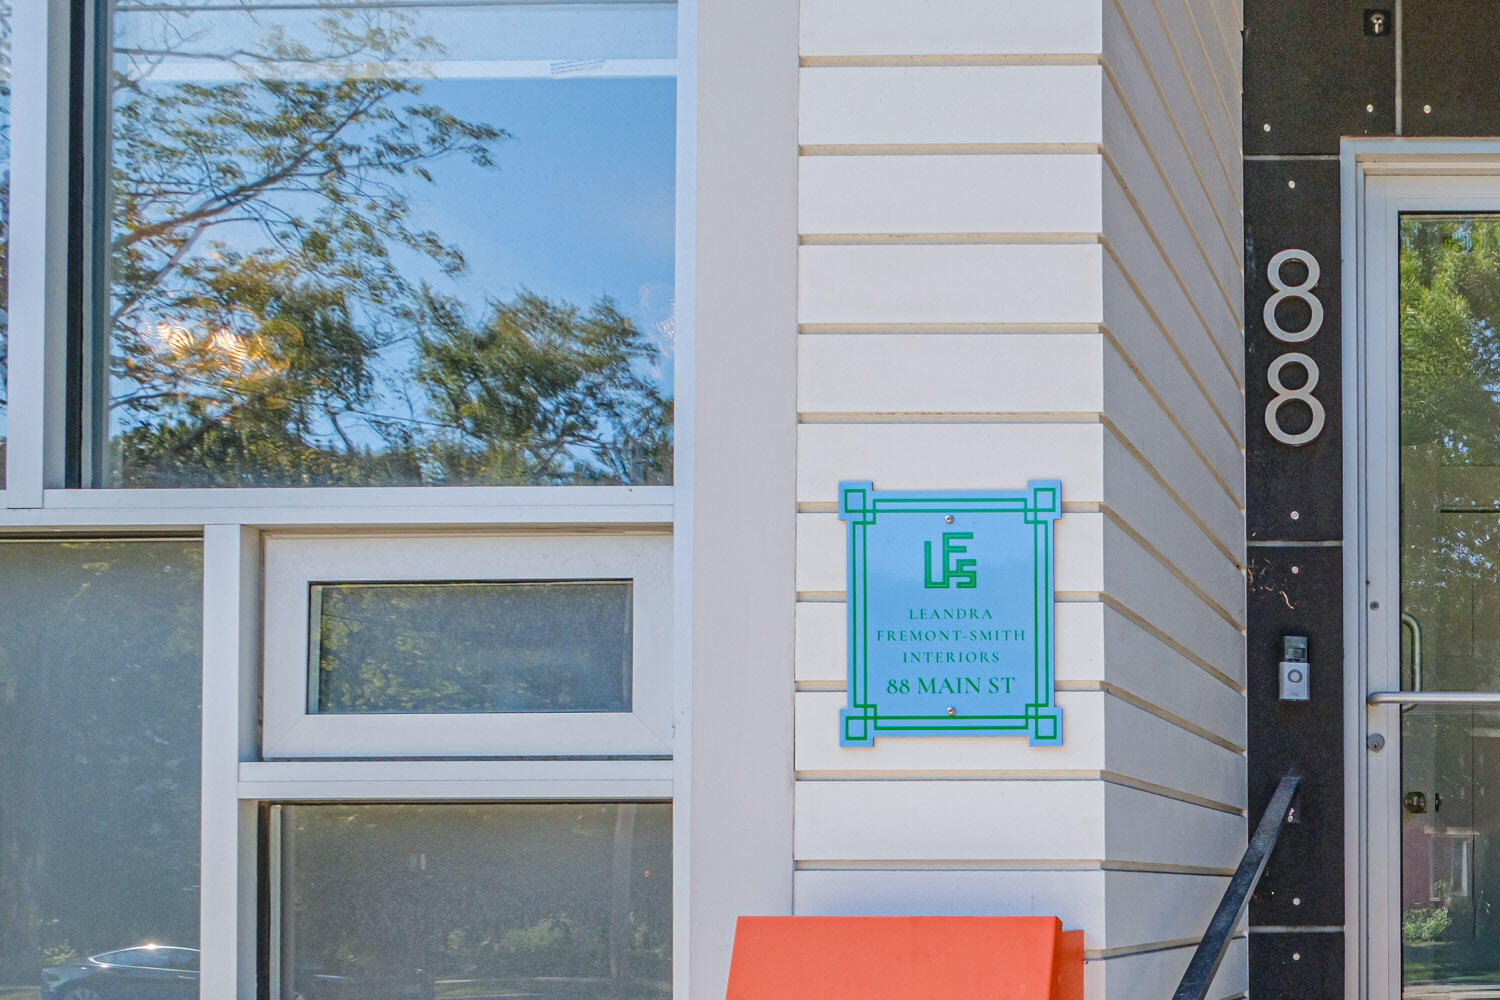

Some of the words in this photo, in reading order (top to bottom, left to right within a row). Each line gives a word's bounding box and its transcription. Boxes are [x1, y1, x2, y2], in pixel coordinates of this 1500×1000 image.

[1262, 248, 1326, 446] 88
[909, 608, 993, 620] LEANDRA
[876, 629, 1026, 642] FREMONT-SMITH
[903, 651, 1000, 664] INTERIORS
[886, 678, 911, 695] 88
[917, 677, 981, 695] MAIN
[988, 676, 1016, 695] ST
